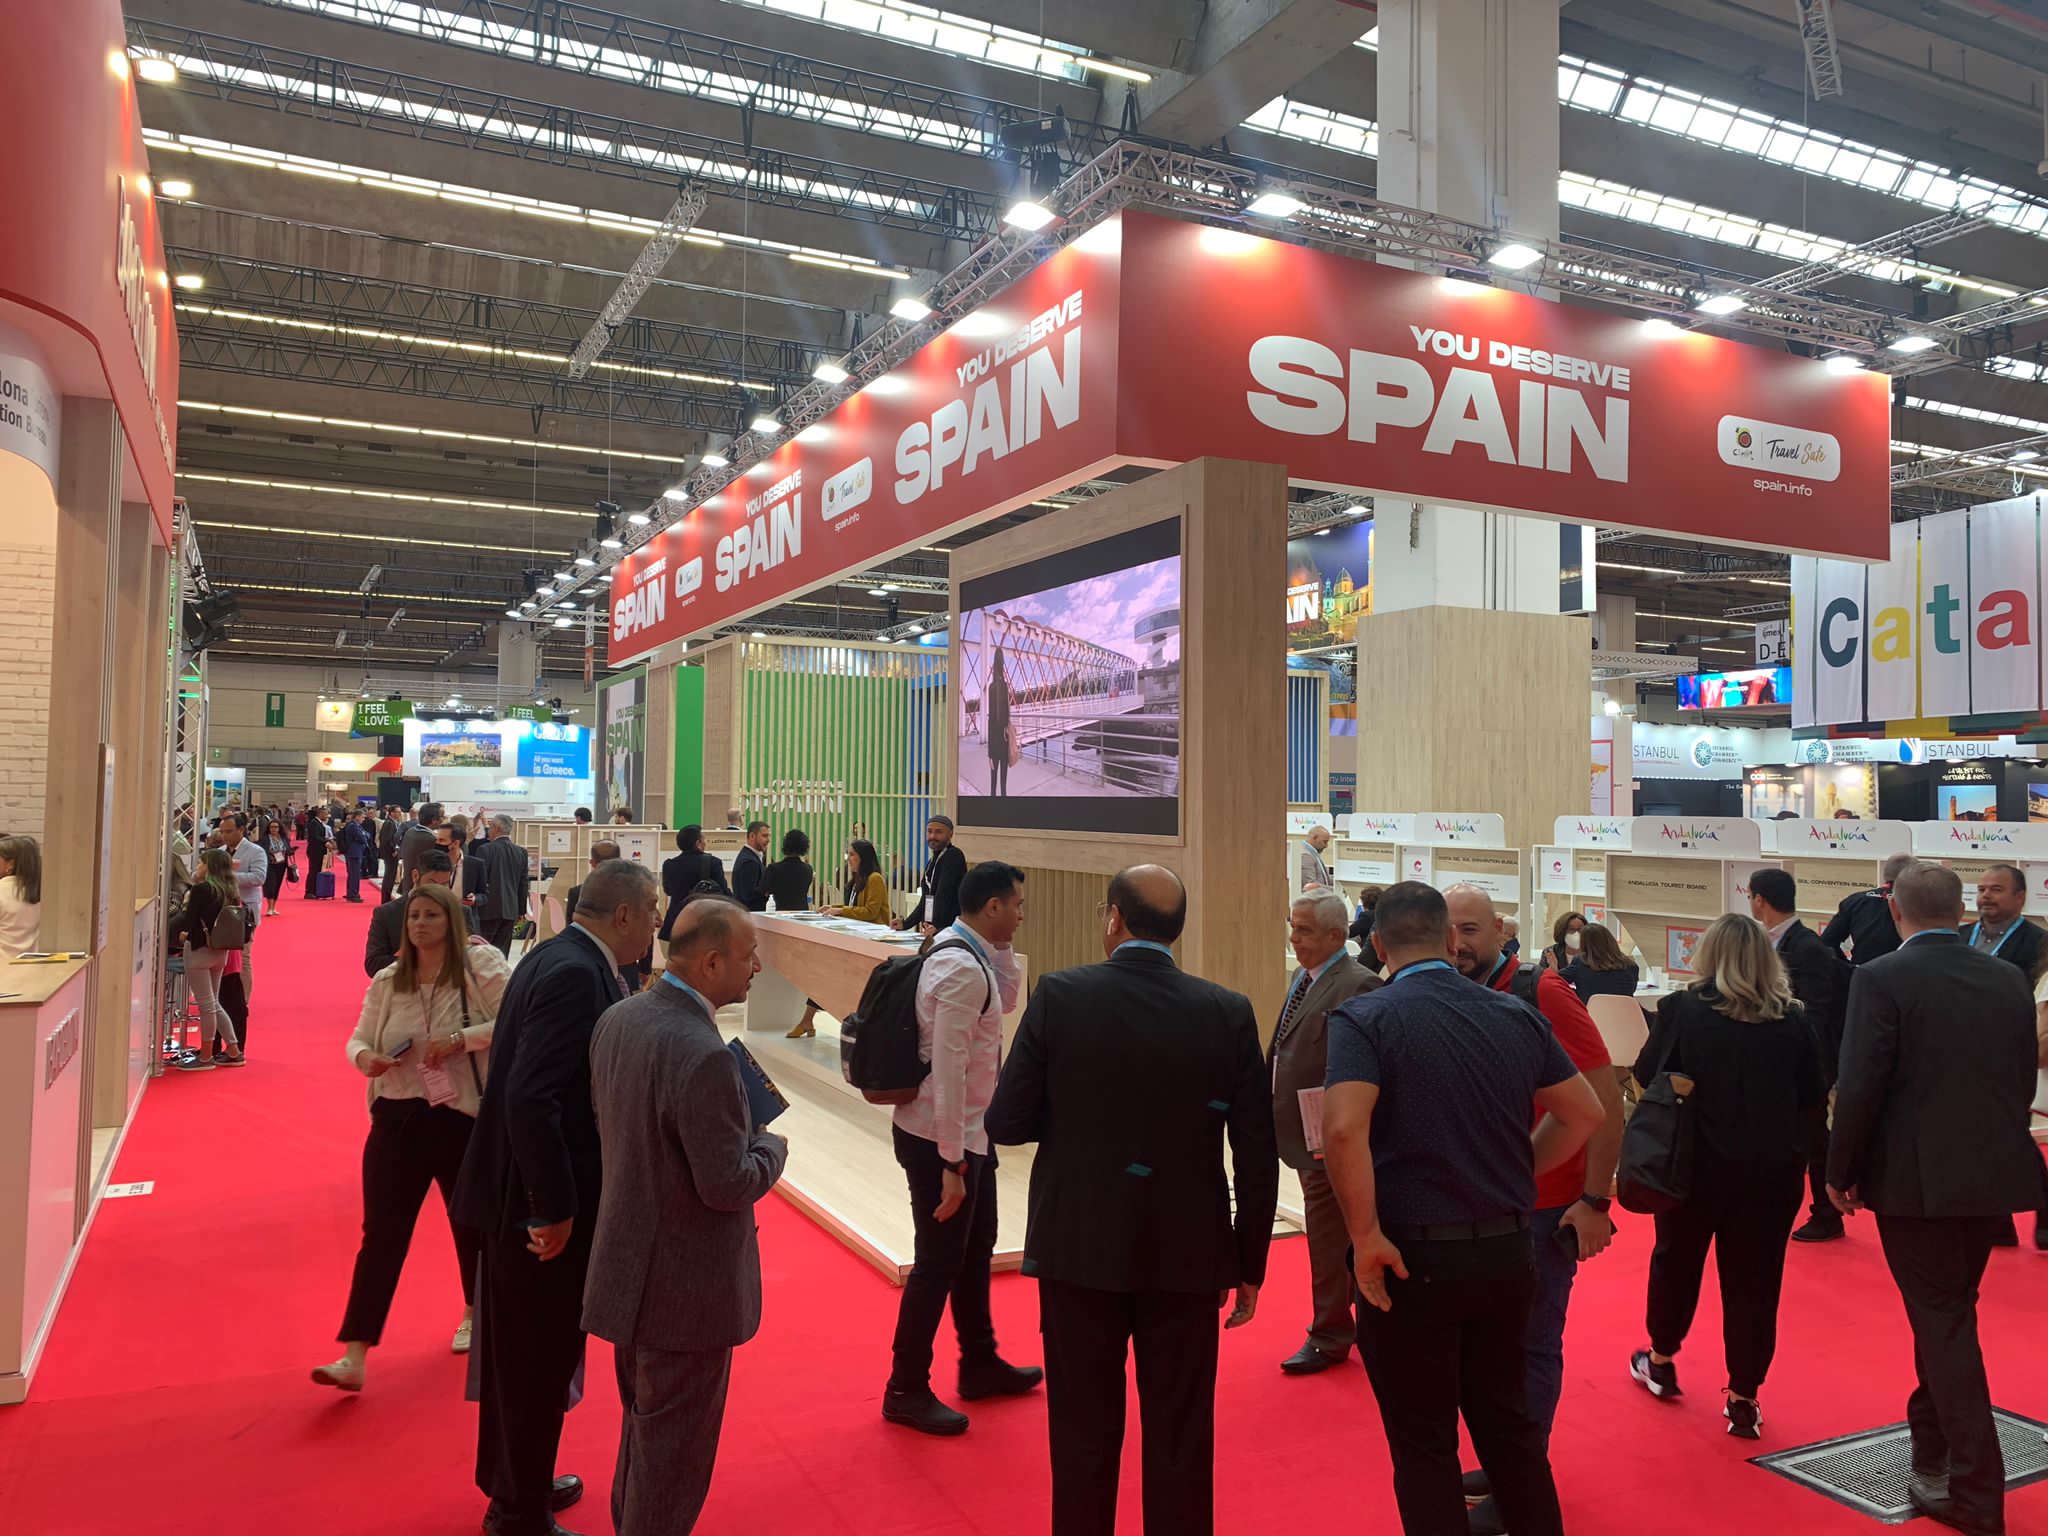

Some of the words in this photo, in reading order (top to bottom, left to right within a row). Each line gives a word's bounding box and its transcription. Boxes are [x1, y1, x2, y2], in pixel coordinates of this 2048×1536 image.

[956, 349, 990, 388] YOU
[995, 289, 1082, 366] DESERVE
[1409, 325, 1480, 360] YOU
[1488, 340, 1630, 392] DESERVE
[894, 325, 1081, 505] SPAIN
[1246, 335, 1630, 483] SPAIN
[1766, 439, 1800, 460] Travel
[1801, 442, 1825, 464] Safe
[746, 494, 761, 518] YOU
[763, 468, 802, 506] DESERVE
[1753, 479, 1813, 497] spain.info
[715, 492, 802, 592] SPAIN
[614, 573, 667, 642] SPAIN
[358, 715, 401, 727] SLOVENI
[365, 703, 388, 714] FEEL
[518, 708, 535, 720] FEEL
[607, 718, 646, 755] SPAIN
[1633, 744, 1680, 759] STANBUL
[1661, 823, 1721, 841] Andalucía
[1809, 825, 1870, 842] Andalucía
[1950, 826, 2013, 843] Andalucía
